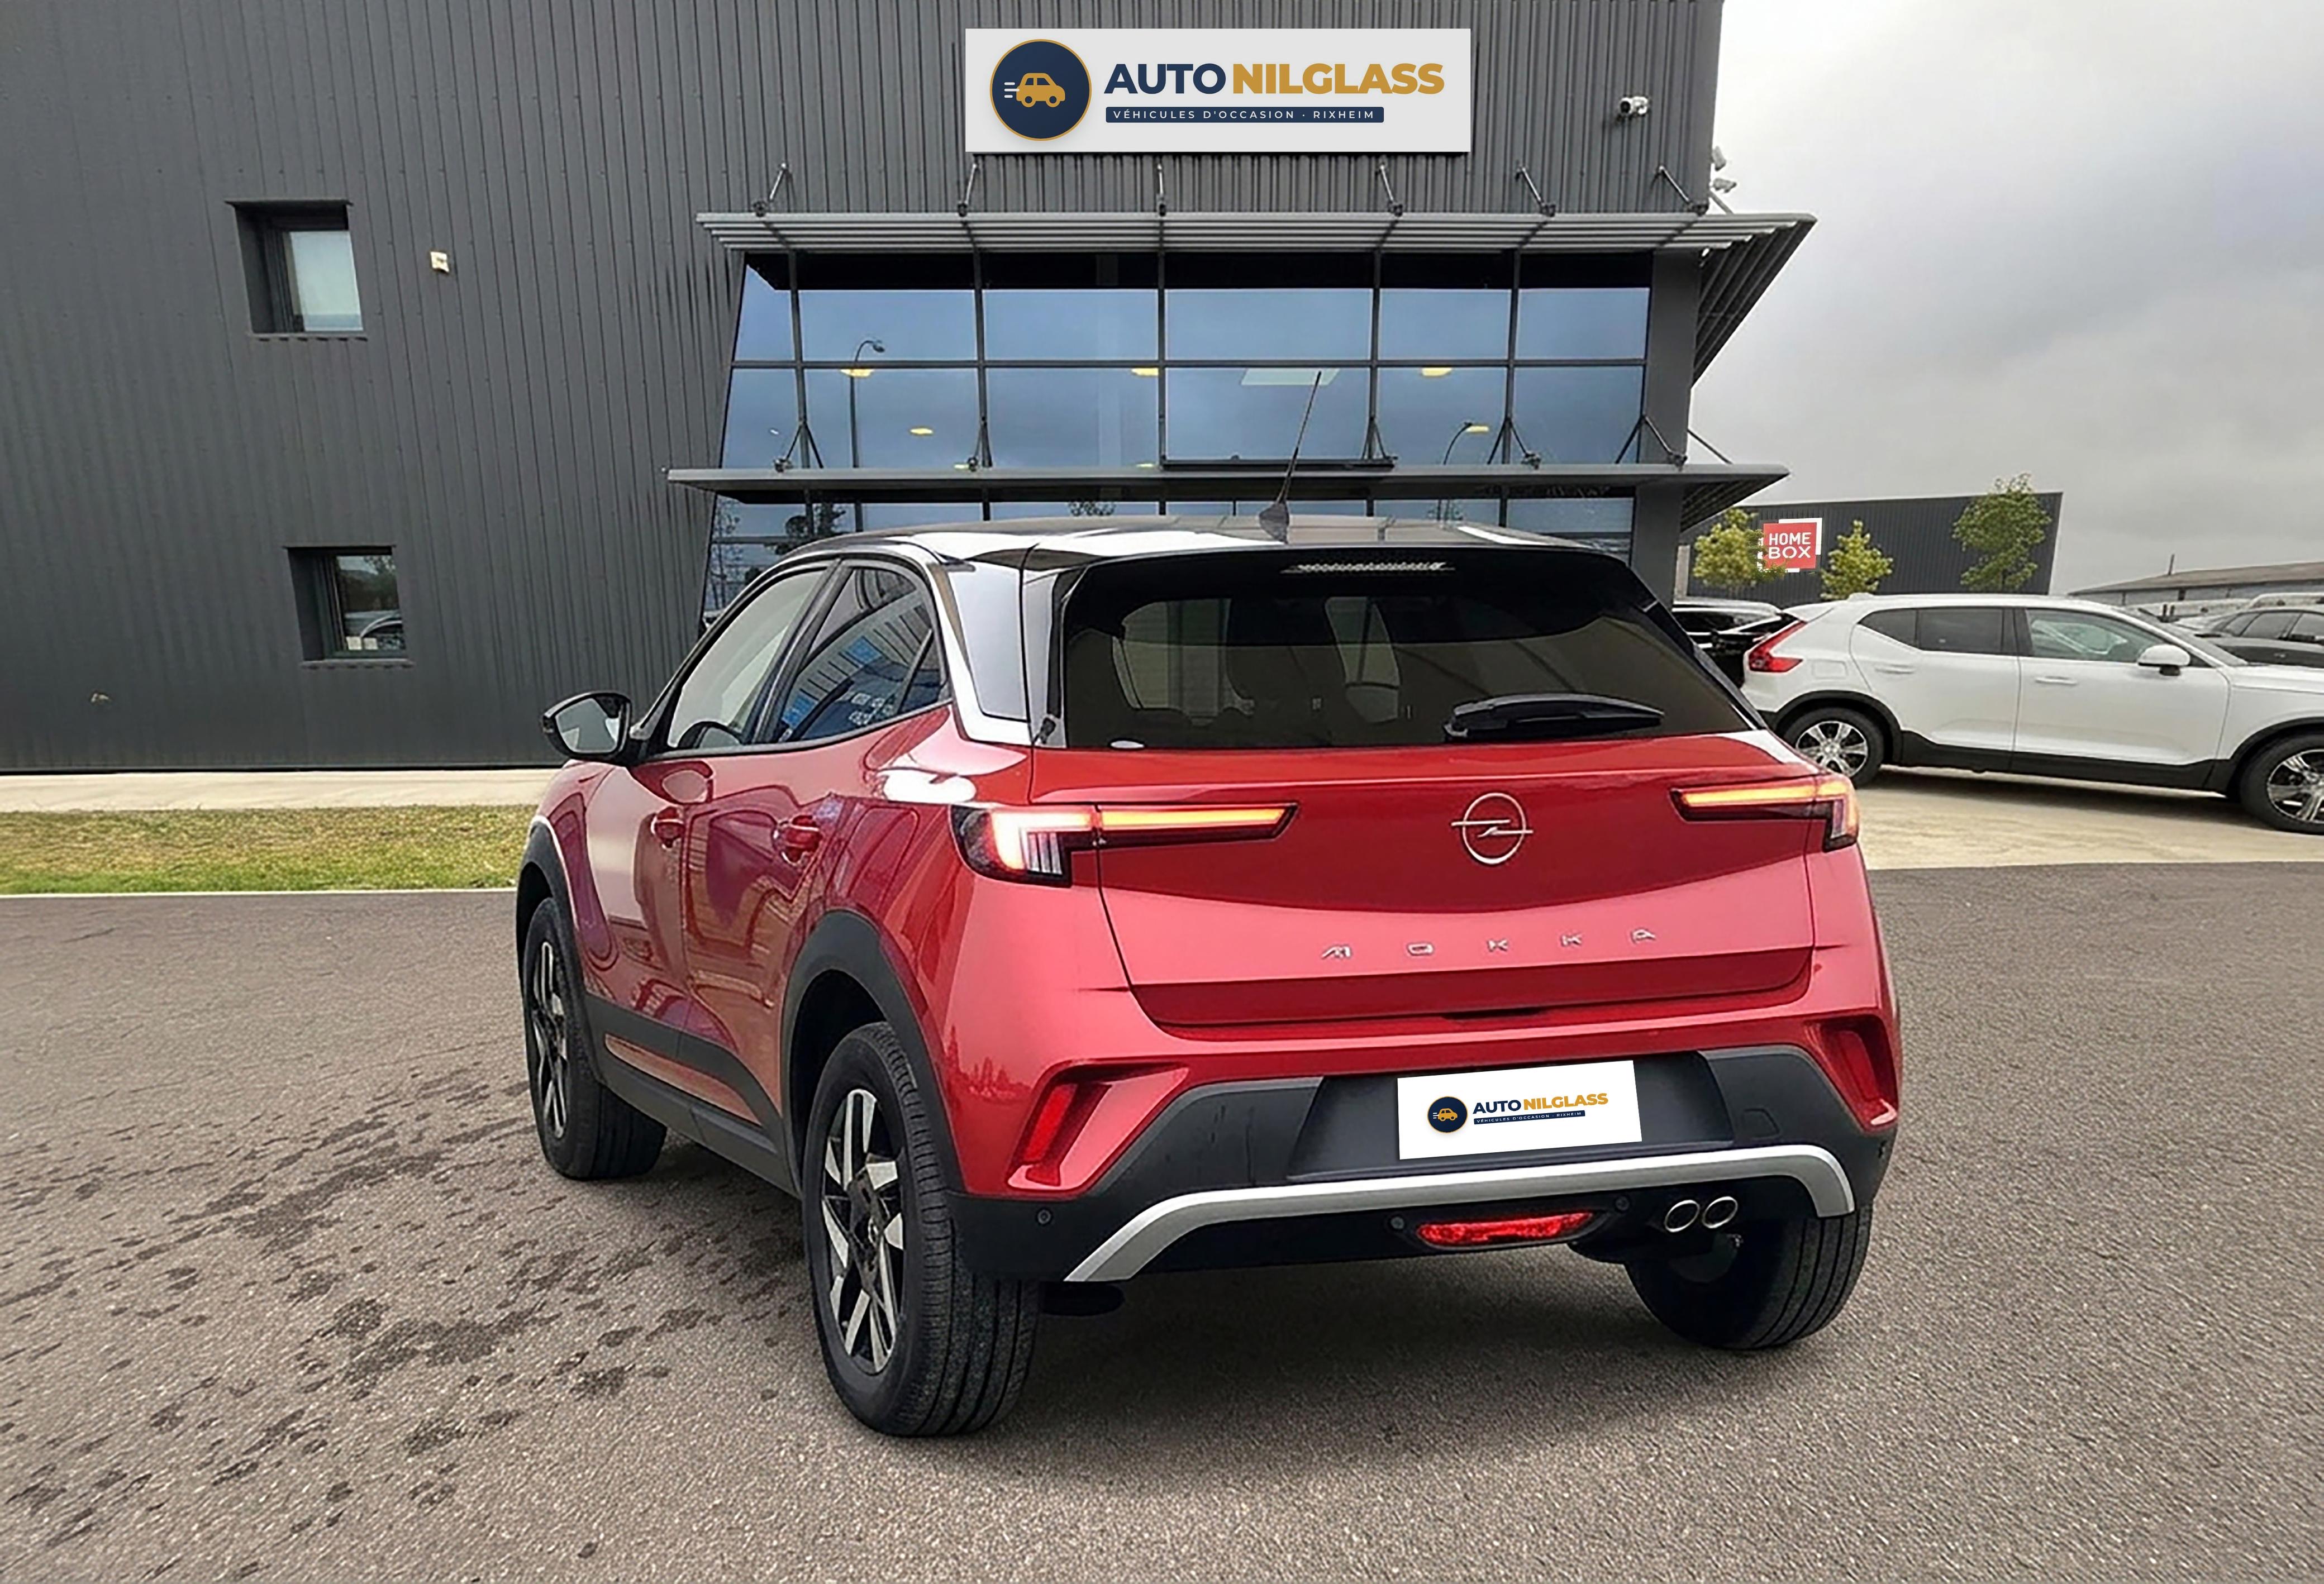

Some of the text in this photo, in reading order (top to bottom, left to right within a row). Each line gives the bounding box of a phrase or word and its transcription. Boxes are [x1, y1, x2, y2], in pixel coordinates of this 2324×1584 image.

[1104, 63, 1445, 94] AUTO NILGLASS
[1113, 108, 1373, 119] VÉHICULES D'OCCASION RIXHEIM
[1769, 532, 1811, 545] HOME
[1768, 546, 1811, 559] BOX
[1473, 1092, 1609, 1114] AUTO NILGLASS
